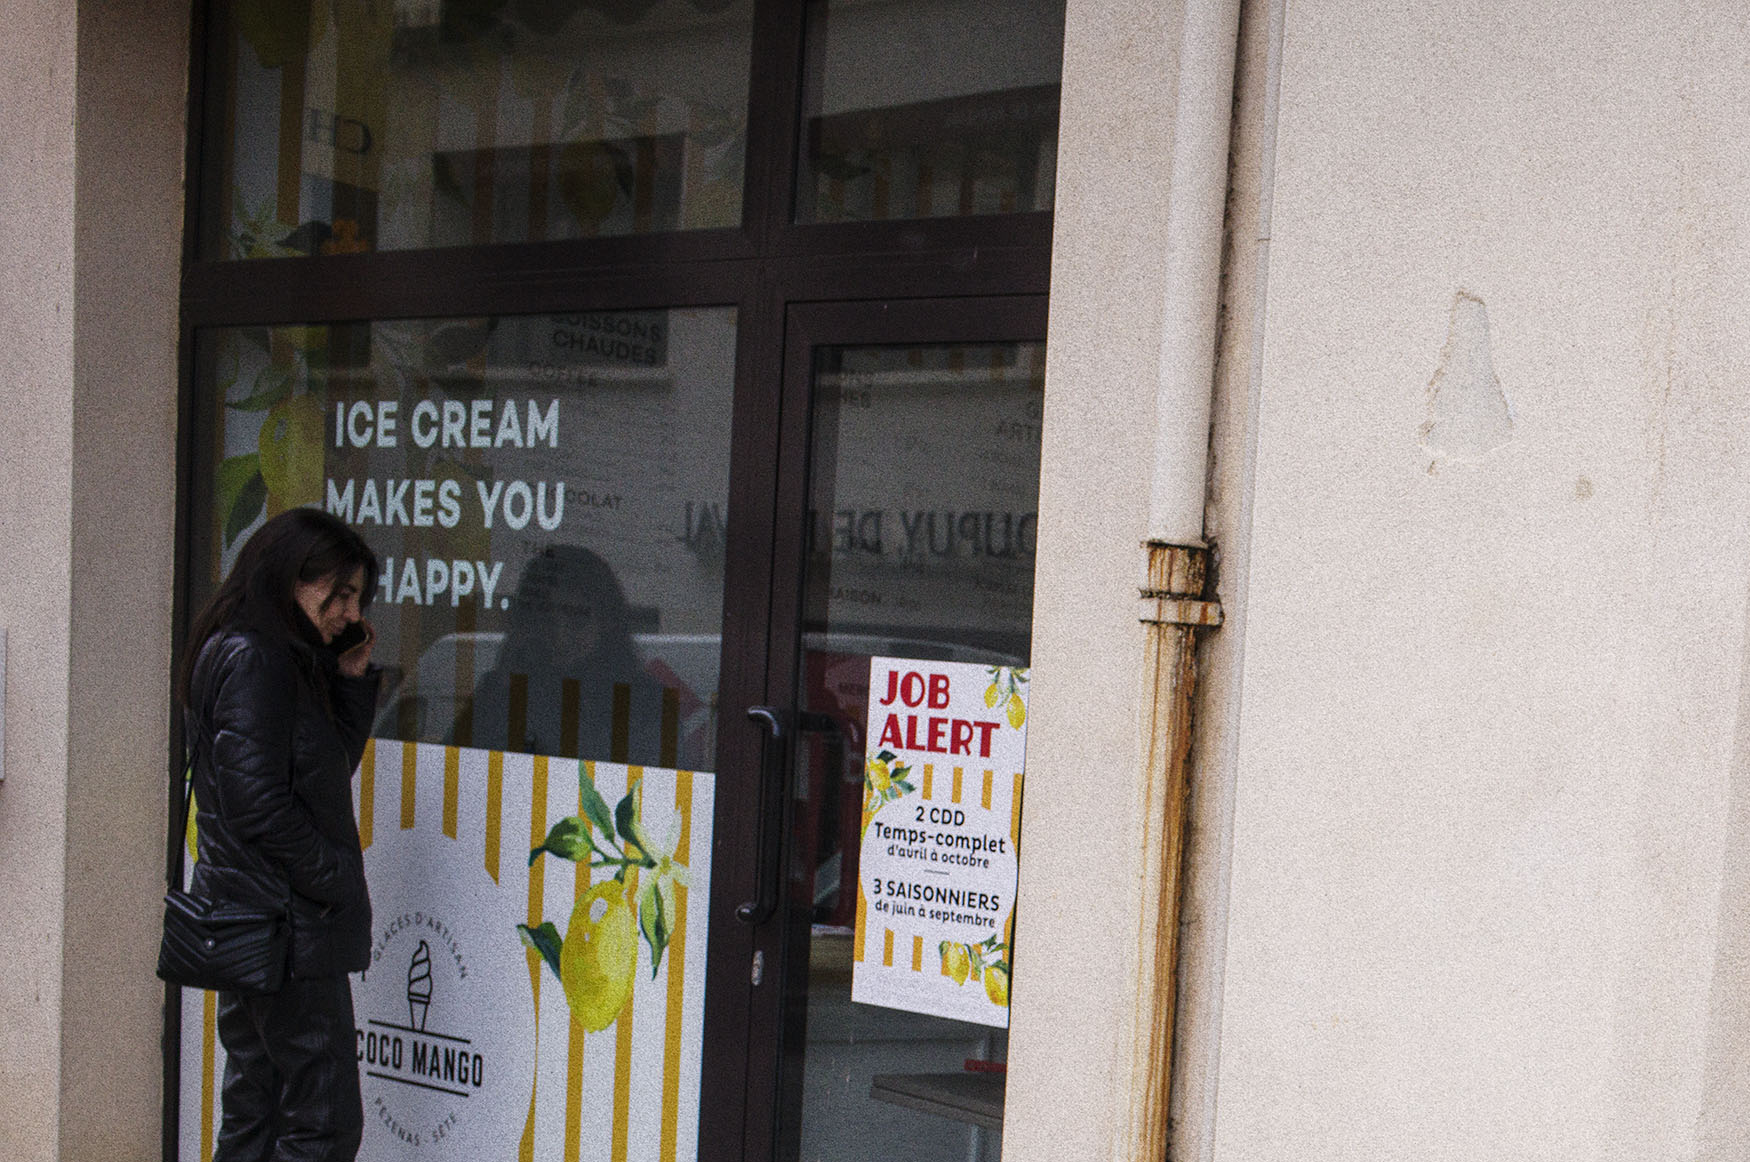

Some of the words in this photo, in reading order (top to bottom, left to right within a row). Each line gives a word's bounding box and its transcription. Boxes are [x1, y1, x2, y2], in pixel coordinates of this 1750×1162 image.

[335, 401, 399, 448] ICE
[411, 400, 561, 448] CREAM
[327, 478, 462, 528] MAKES
[476, 480, 566, 531] YOU
[373, 556, 510, 611] HAPPY.
[879, 670, 950, 710] JOB
[878, 713, 1001, 758] ALERT
[915, 805, 926, 823] 2
[929, 807, 966, 827] CDD
[874, 822, 1006, 854] Temps-complet
[887, 844, 928, 862] d'avril
[930, 849, 939, 862] à
[941, 852, 990, 869] octobre
[873, 878, 883, 895] 3
[886, 880, 1001, 912] SAISONNIERS
[874, 899, 890, 913] de
[891, 901, 916, 918] juin
[918, 904, 927, 918] à
[929, 907, 996, 929] septembre
[356, 1029, 403, 1069] COCO
[412, 1040, 484, 1088] MANGO
